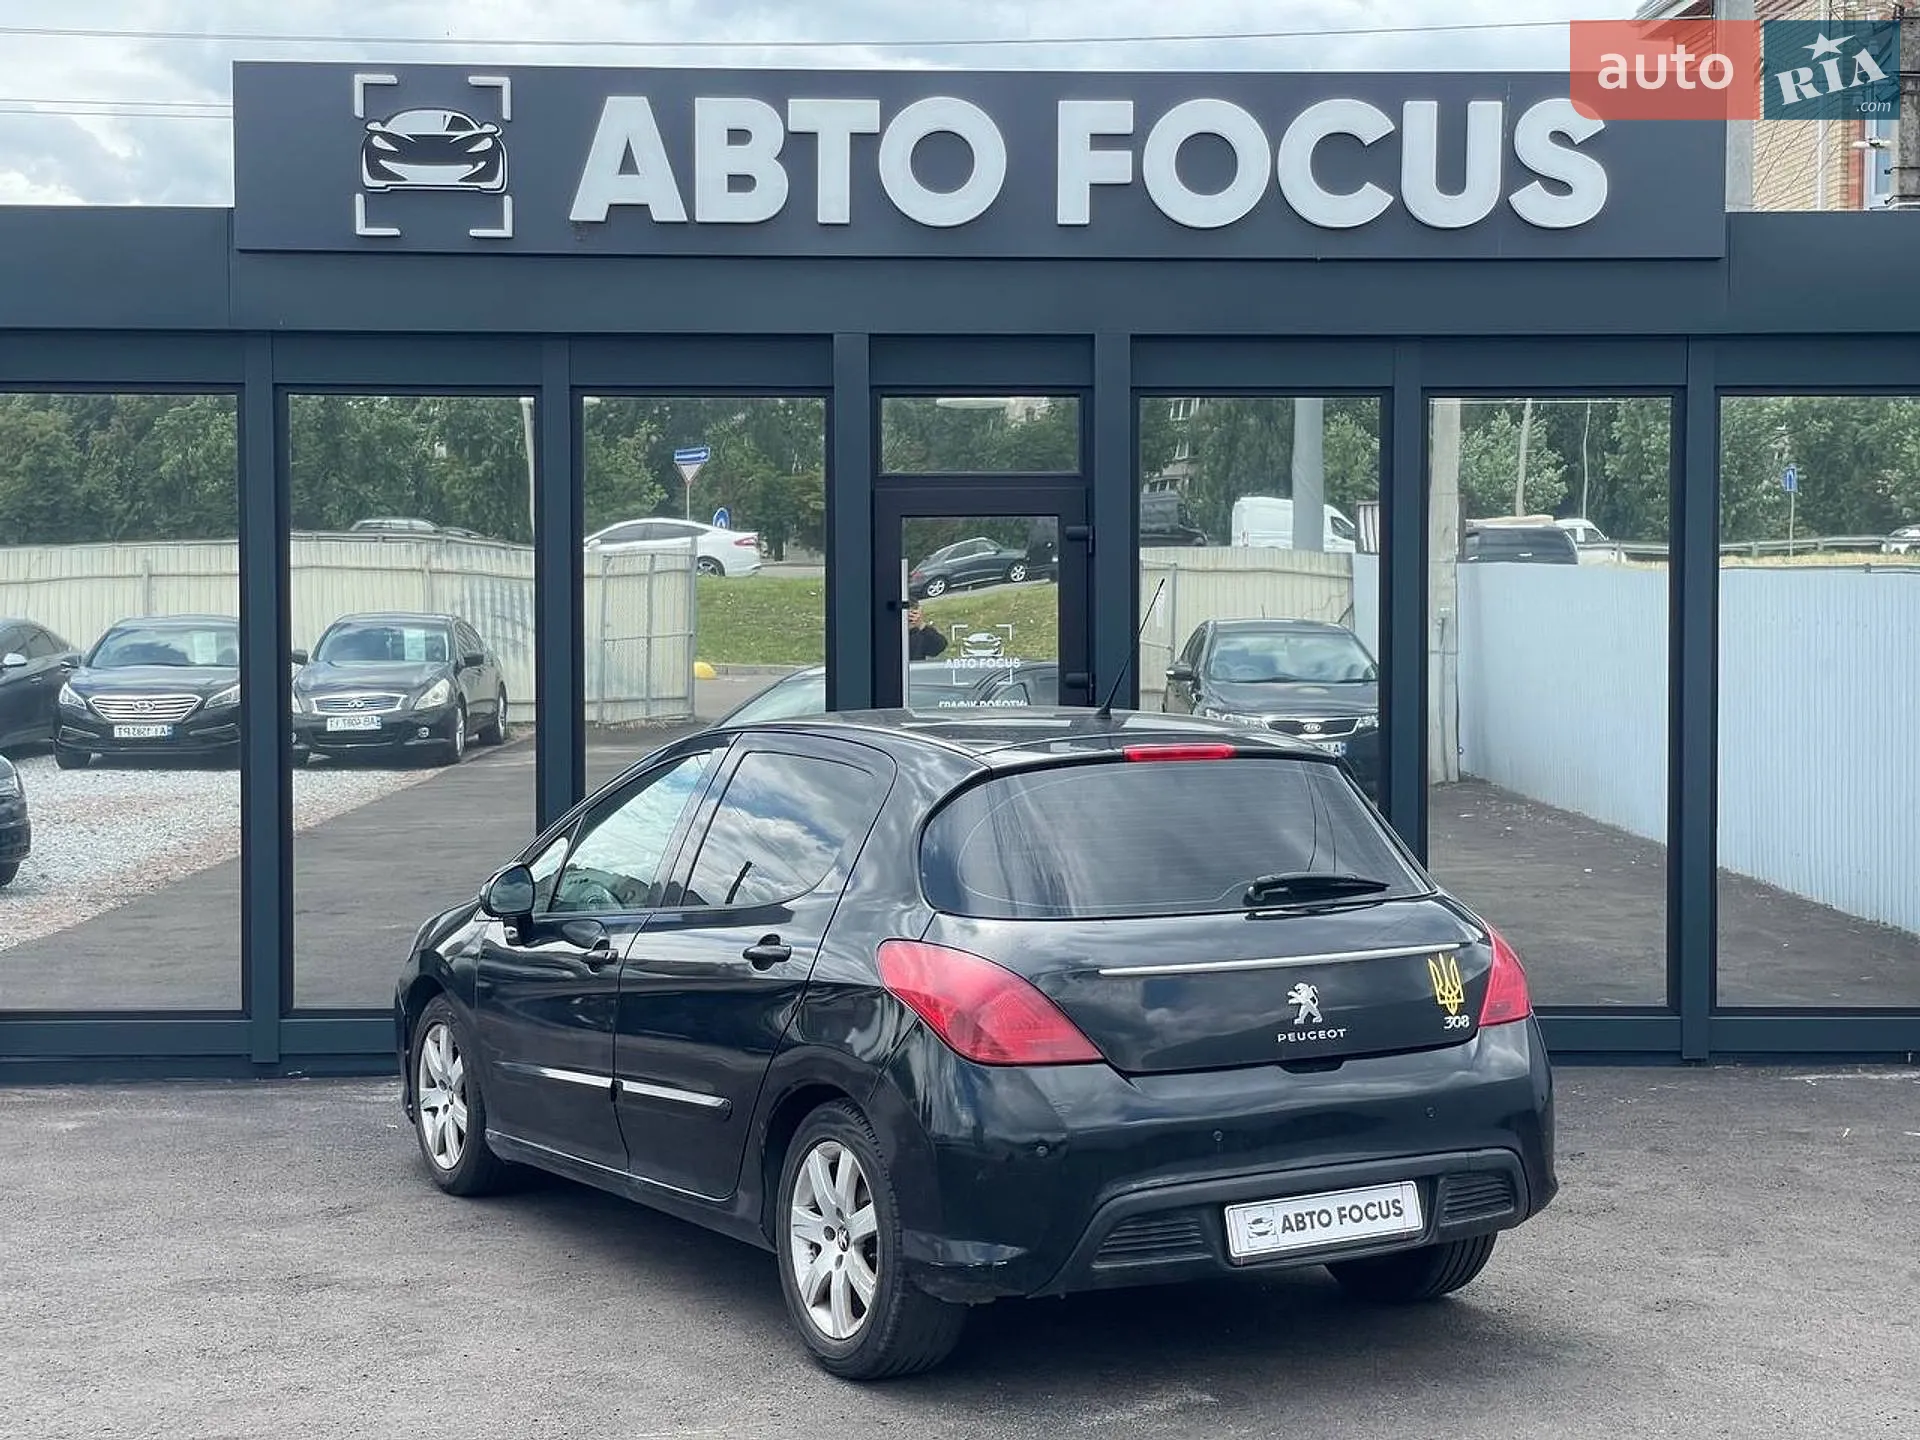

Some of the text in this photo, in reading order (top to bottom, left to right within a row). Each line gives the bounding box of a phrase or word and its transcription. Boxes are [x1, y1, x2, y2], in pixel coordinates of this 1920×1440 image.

[569, 95, 1609, 229] АВТО FOCUS
[944, 658, 1021, 669] АВТО FOCUS
[1443, 1015, 1470, 1029] 308
[1277, 1028, 1347, 1043] PEUGEOT
[1281, 1198, 1404, 1234] АВТО FOCUS
